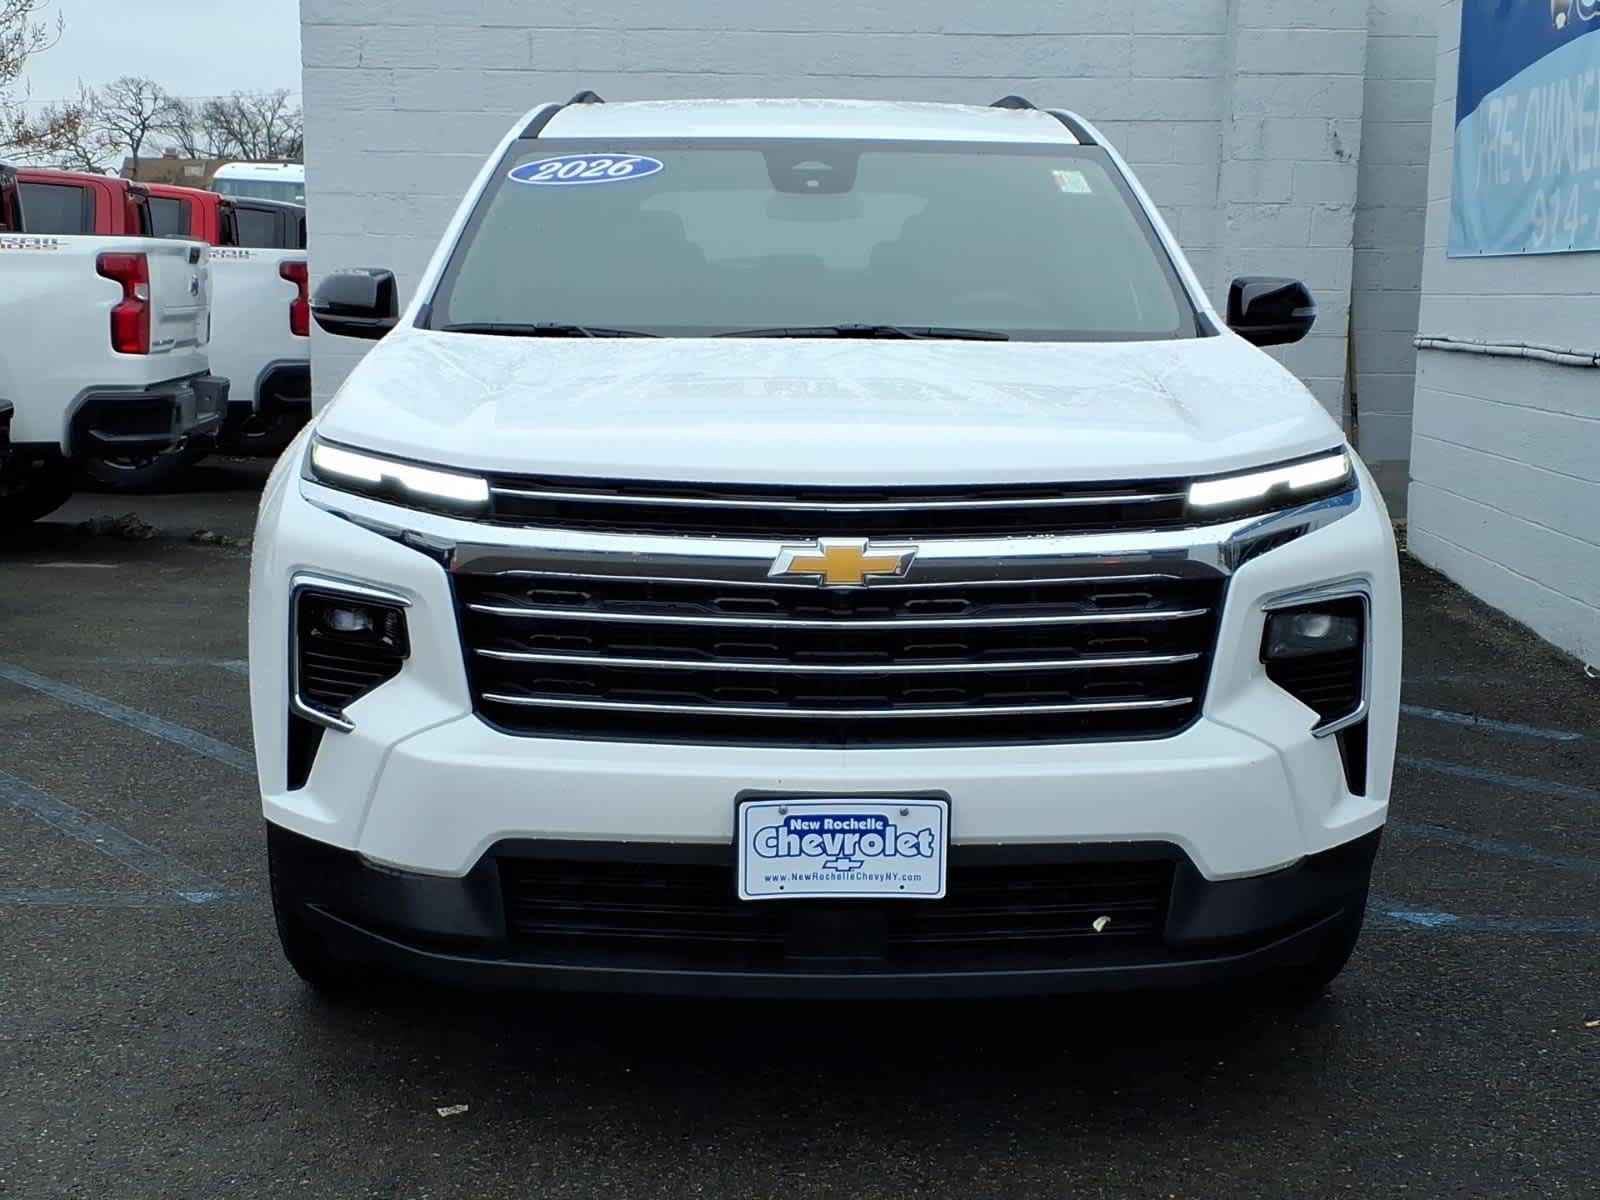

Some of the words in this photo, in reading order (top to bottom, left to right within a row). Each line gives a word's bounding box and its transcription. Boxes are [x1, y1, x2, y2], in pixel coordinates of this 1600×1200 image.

[1473, 66, 1600, 196] RE-OWNE
[528, 158, 642, 181] 2026
[790, 818, 820, 830] New
[823, 818, 884, 830] Rochelle
[753, 824, 935, 858] Chevrolet
[764, 871, 922, 882] www.NewRochelleChevyNY.com
